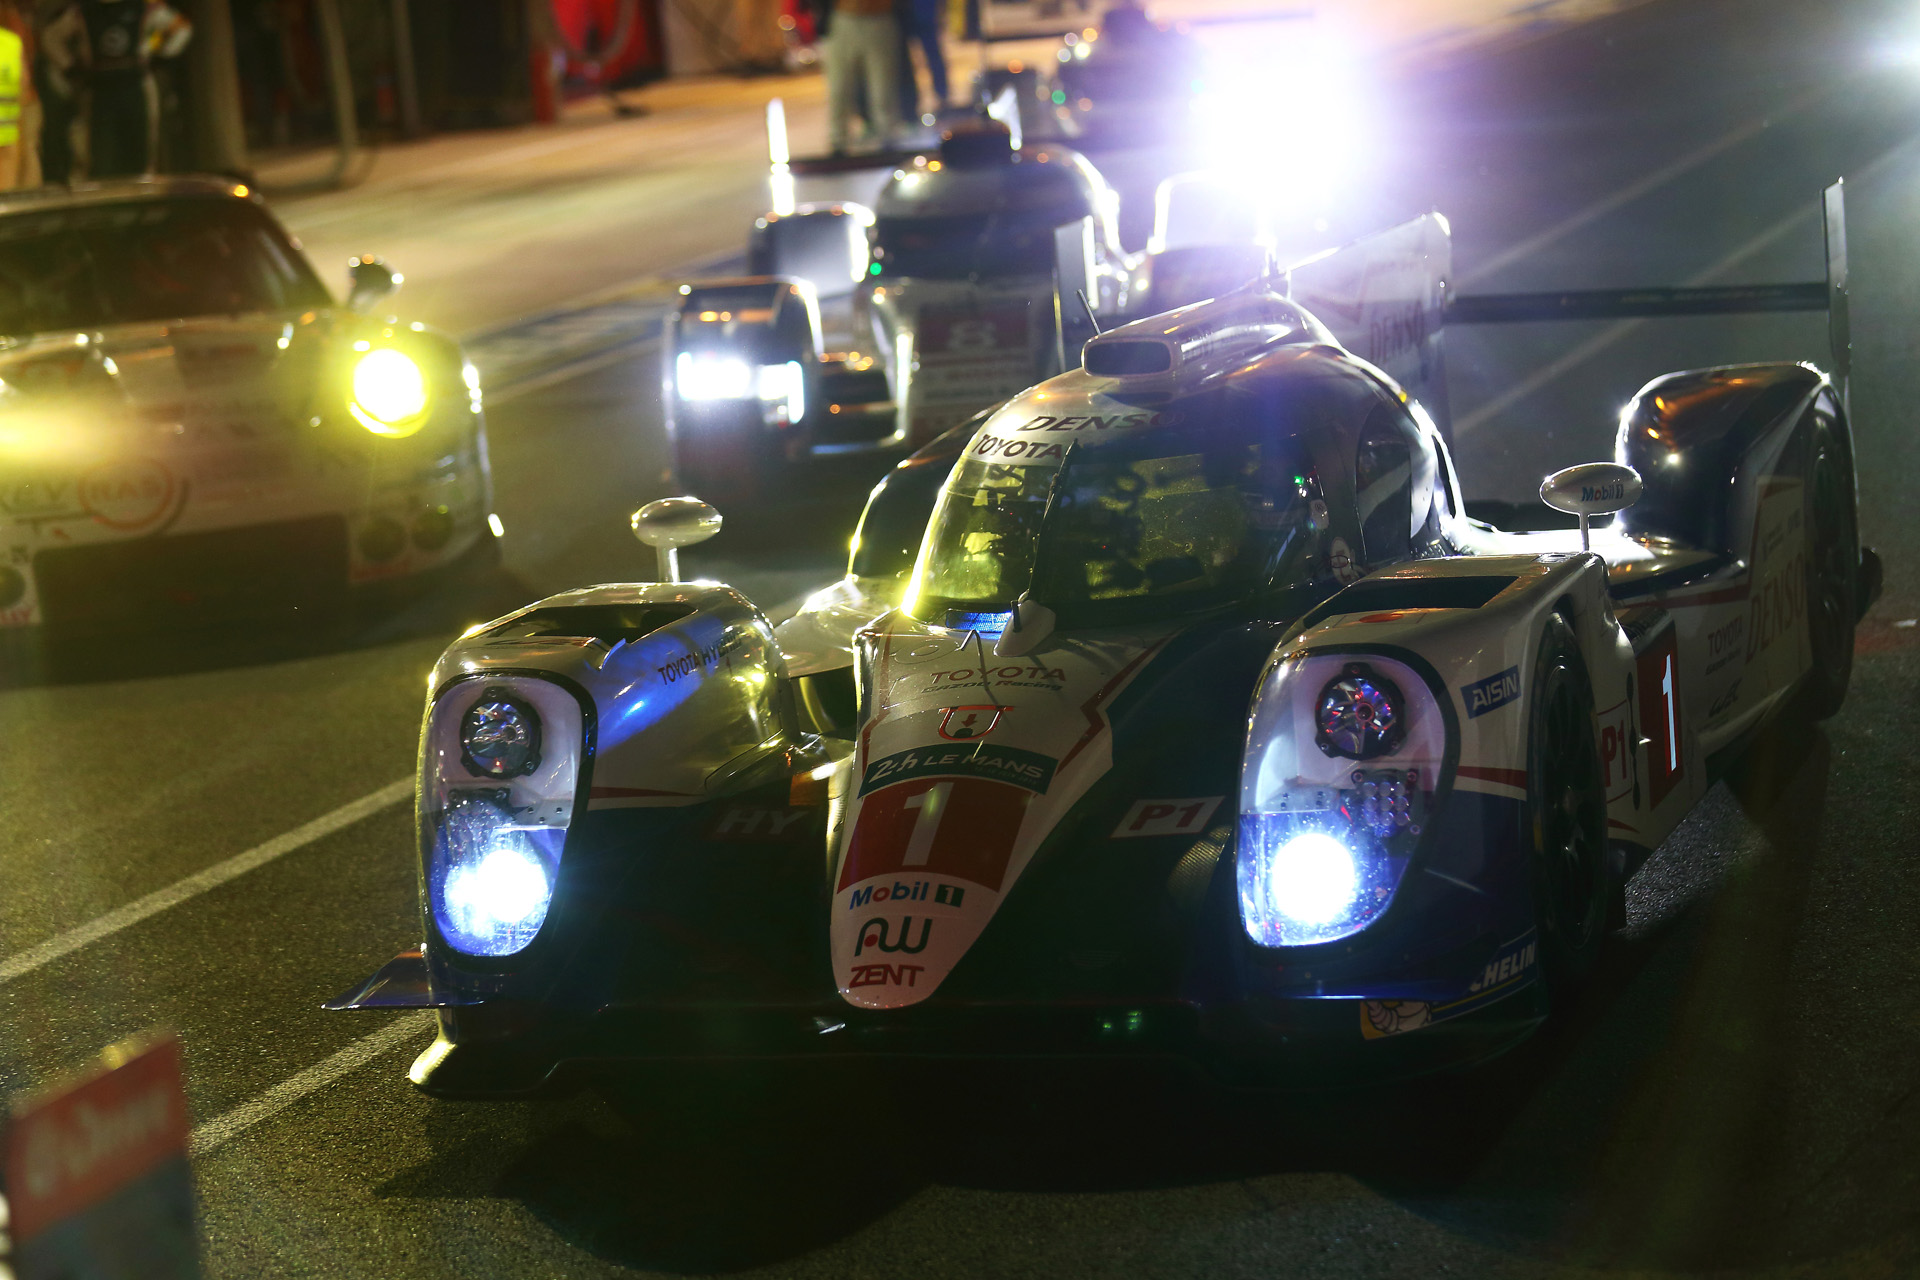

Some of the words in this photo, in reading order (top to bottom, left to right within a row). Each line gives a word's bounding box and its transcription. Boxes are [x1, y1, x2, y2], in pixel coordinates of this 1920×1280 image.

[972, 434, 1063, 460] TOYOTA
[1581, 484, 1615, 502] Mobil
[1745, 552, 1805, 664] DENSO
[658, 652, 701, 685] TOYOTA
[930, 667, 1066, 684] TOYOTA
[996, 680, 1064, 692] Racing
[1472, 673, 1518, 711] AISIN
[1661, 654, 1677, 772] 1
[922, 754, 960, 766] LE
[961, 753, 1044, 779] MANS
[1602, 720, 1627, 787] P1
[715, 809, 809, 836] HY
[902, 782, 955, 866] 1
[1128, 801, 1205, 831] P1
[849, 881, 929, 910] Mobil
[848, 963, 924, 989] ZENT
